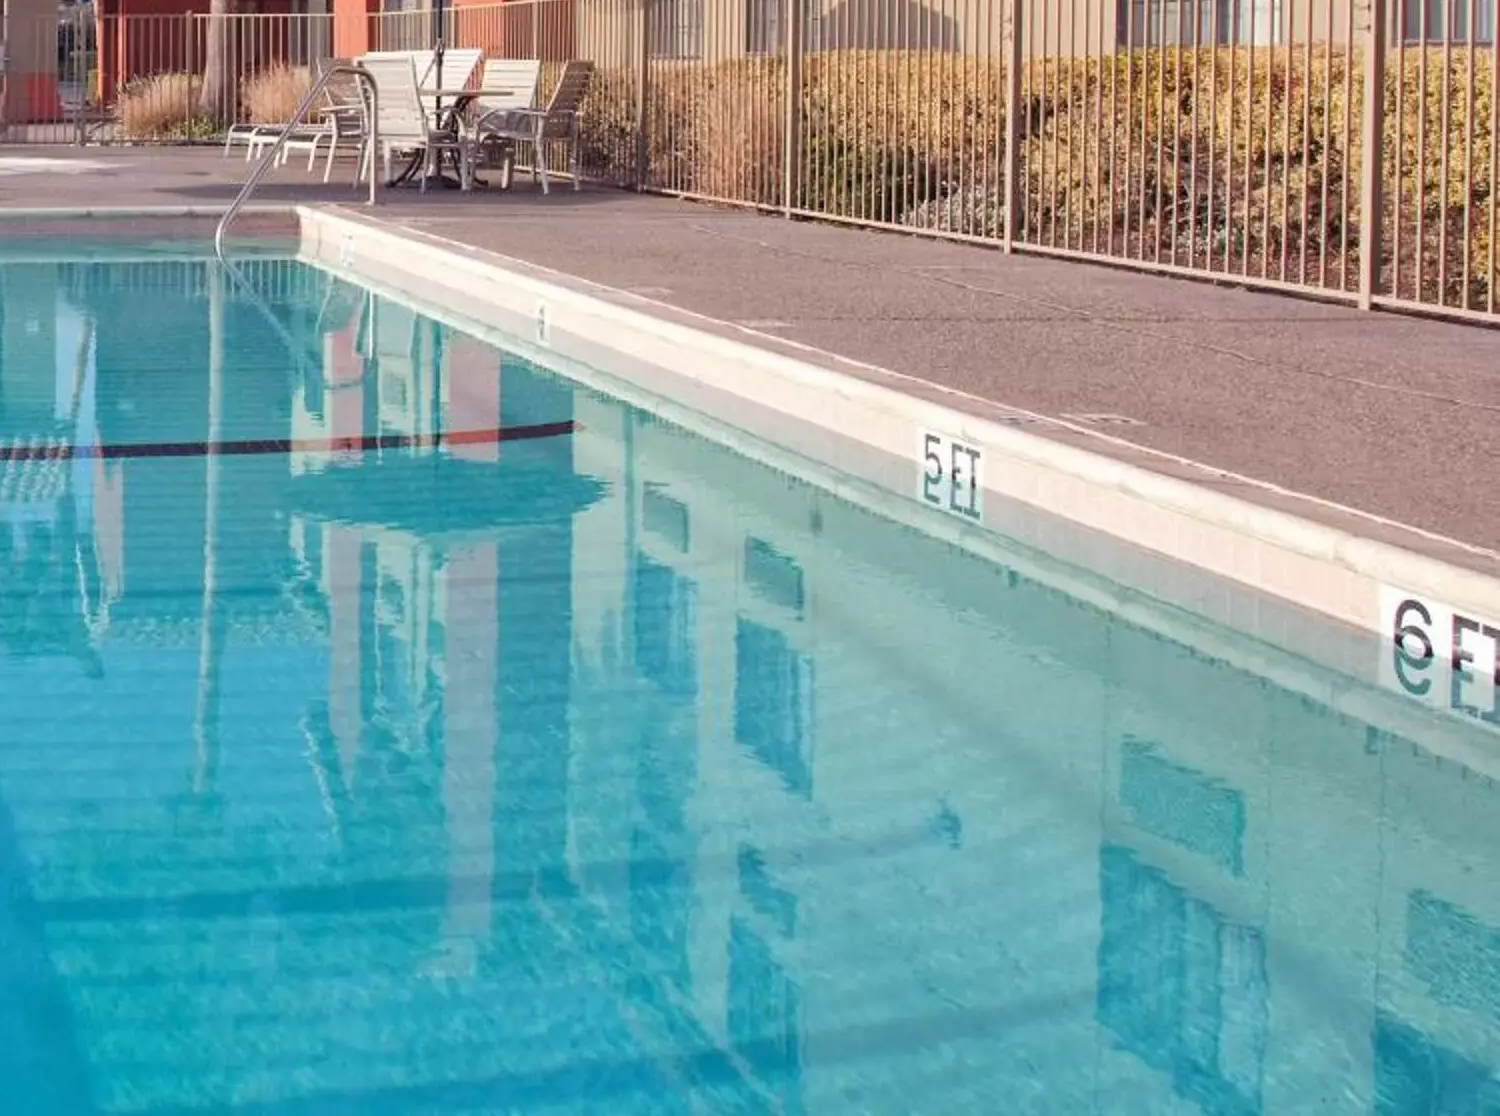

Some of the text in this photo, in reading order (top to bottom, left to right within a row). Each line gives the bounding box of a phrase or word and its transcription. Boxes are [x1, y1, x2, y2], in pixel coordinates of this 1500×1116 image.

[924, 433, 980, 497] 5 FT
[1394, 599, 1434, 669] 6
